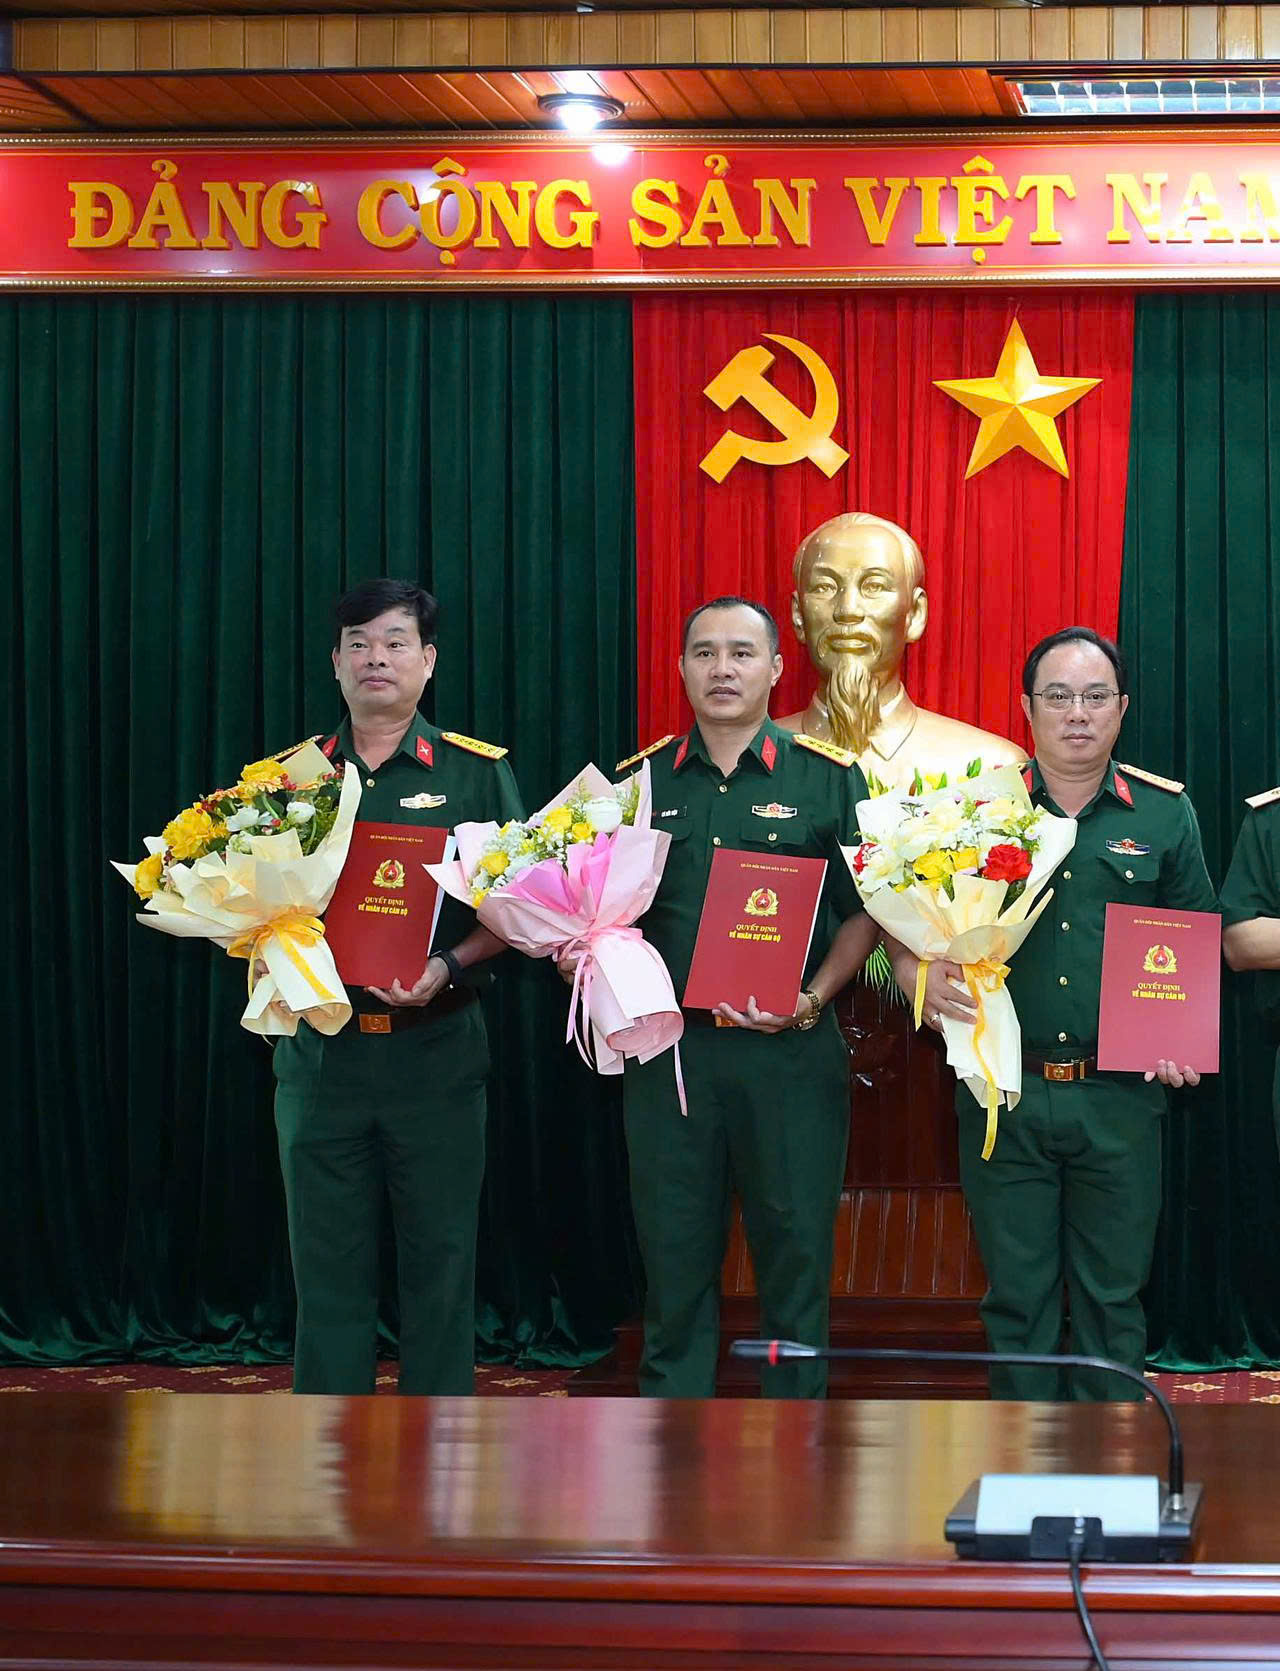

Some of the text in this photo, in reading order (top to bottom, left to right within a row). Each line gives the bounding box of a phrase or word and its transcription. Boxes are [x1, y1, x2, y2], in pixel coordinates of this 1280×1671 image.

[68, 160, 328, 249] ĐẢNG
[357, 158, 599, 265] CỘNG
[628, 155, 818, 248] SẢN
[844, 155, 1077, 264] VIỆT
